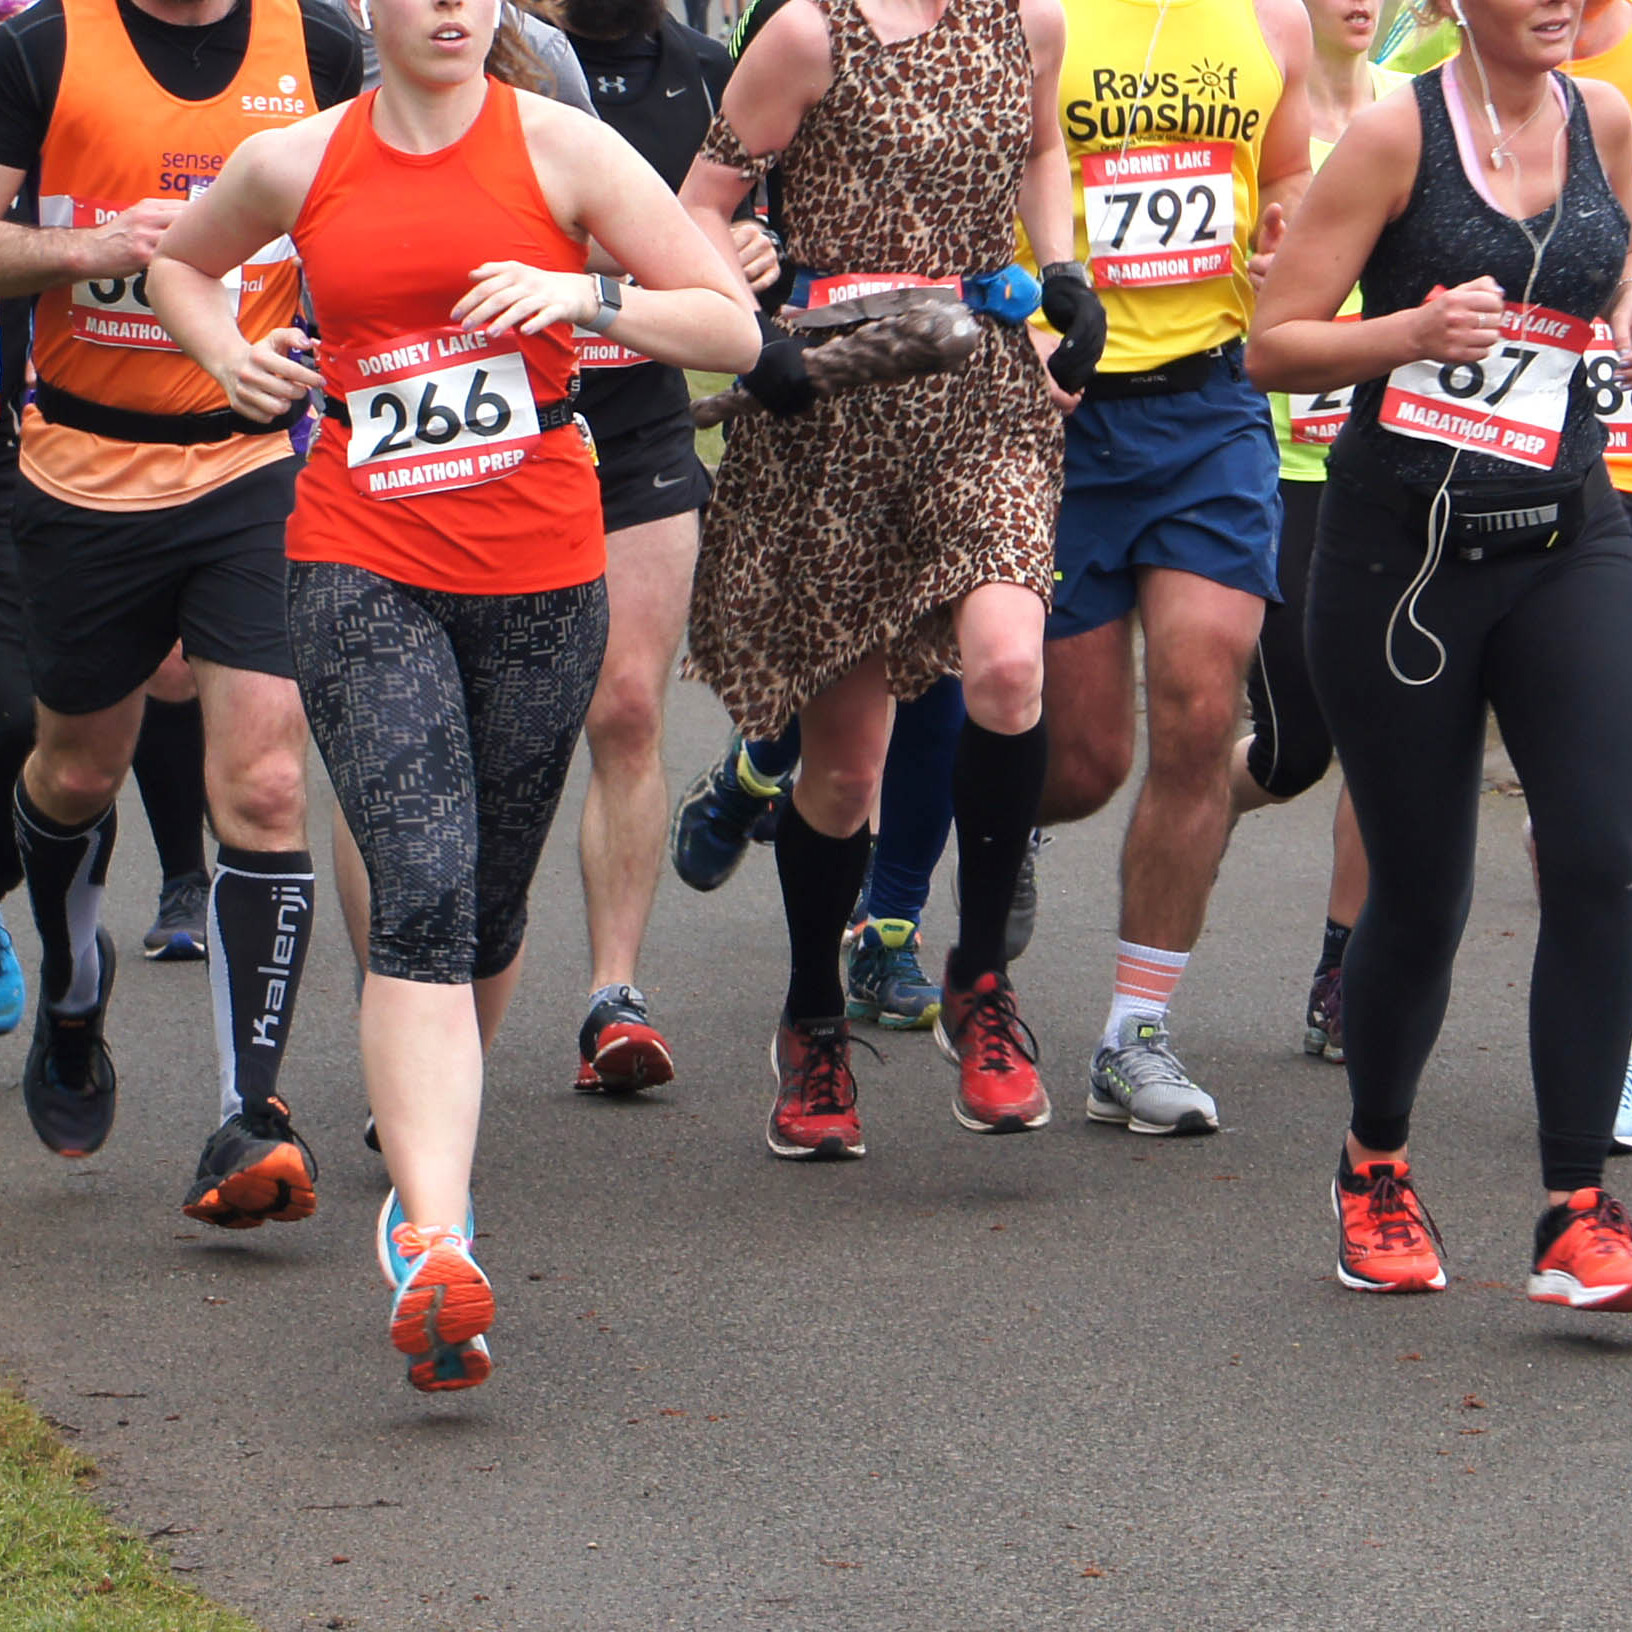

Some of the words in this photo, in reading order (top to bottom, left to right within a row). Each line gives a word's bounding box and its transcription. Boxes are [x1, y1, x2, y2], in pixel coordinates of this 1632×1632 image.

[241, 93, 305, 114] sense
[1092, 67, 1180, 102] Rays
[1065, 94, 1260, 142] Sunshine
[161, 152, 223, 171] sense
[1104, 153, 1171, 177] DORNEY
[1174, 149, 1212, 170] LAKE
[1104, 184, 1217, 251] 792
[1106, 258, 1190, 282] MARATHON
[1192, 253, 1222, 273] PREP
[1525, 313, 1572, 339] LAKE
[356, 341, 431, 377] DORNEY
[435, 329, 489, 358] LAKE
[369, 368, 512, 458] 266
[1396, 400, 1499, 444] MARATHON
[1501, 428, 1547, 456] PREP
[368, 455, 474, 492] MARATHON
[477, 448, 526, 475] PREP
